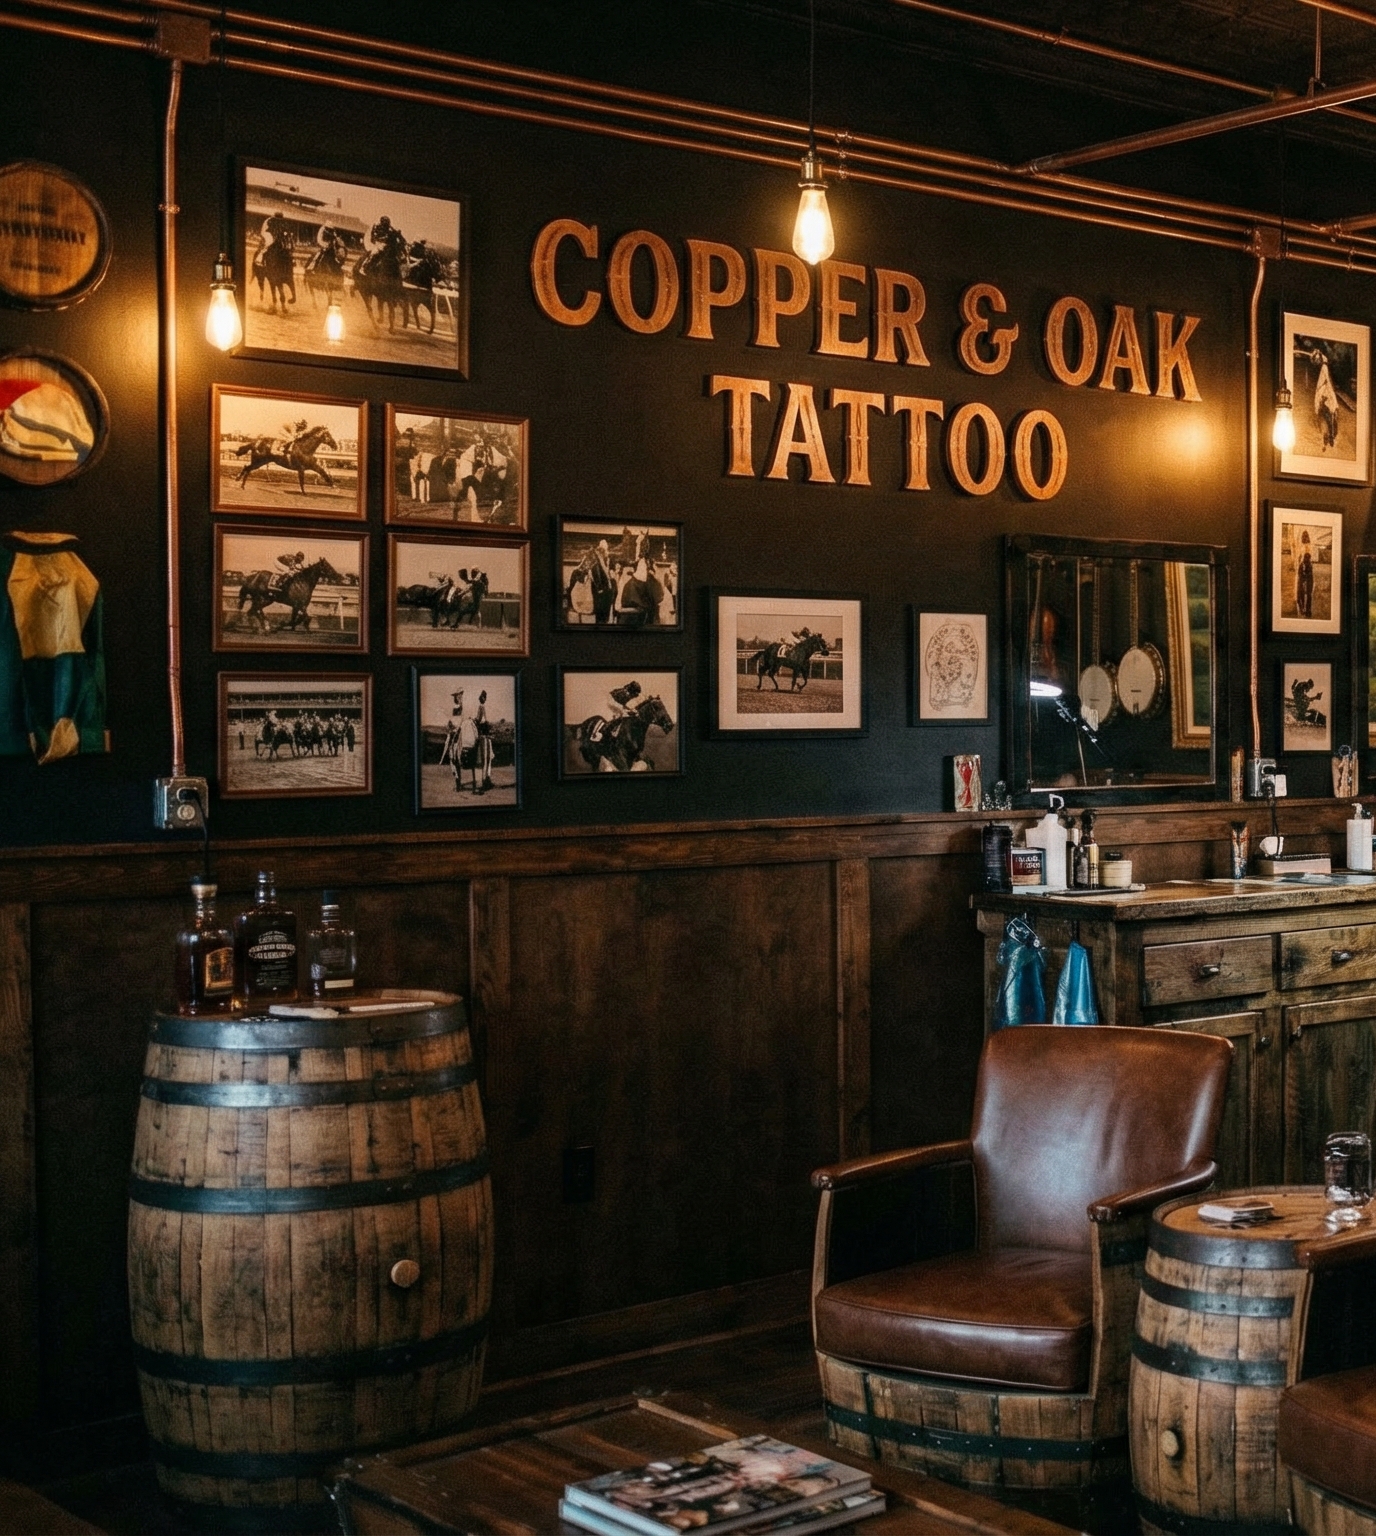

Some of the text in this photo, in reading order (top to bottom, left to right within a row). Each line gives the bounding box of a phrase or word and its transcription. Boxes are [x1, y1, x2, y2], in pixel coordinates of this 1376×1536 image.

[530, 218, 1202, 402] COPPER & OAK
[709, 374, 1068, 501] TATTOO
